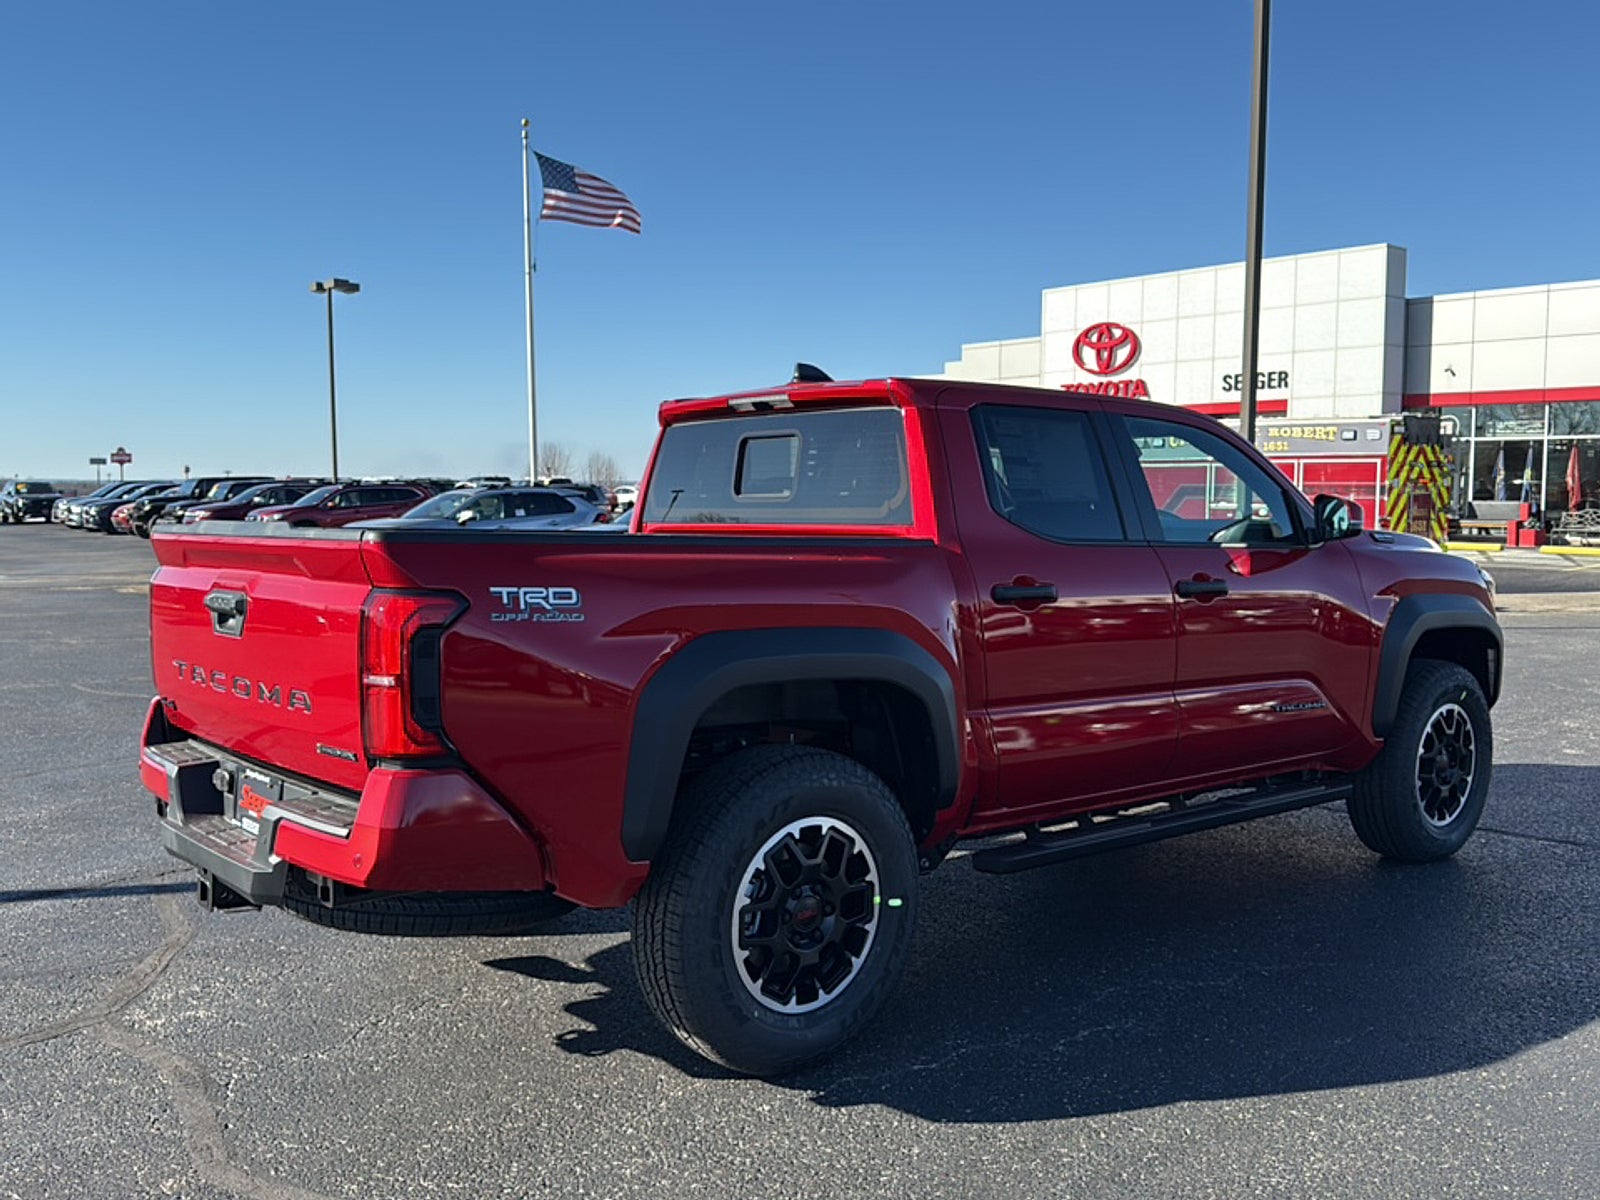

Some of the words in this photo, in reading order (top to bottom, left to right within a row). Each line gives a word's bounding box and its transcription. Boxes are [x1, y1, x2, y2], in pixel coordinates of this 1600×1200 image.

[1222, 371, 1289, 392] SEGER
[1268, 426, 1338, 441] ROBERT
[489, 586, 581, 612] TRD
[490, 613, 530, 621] OFF
[533, 613, 585, 621] ROAD
[172, 659, 313, 715] TACOMA
